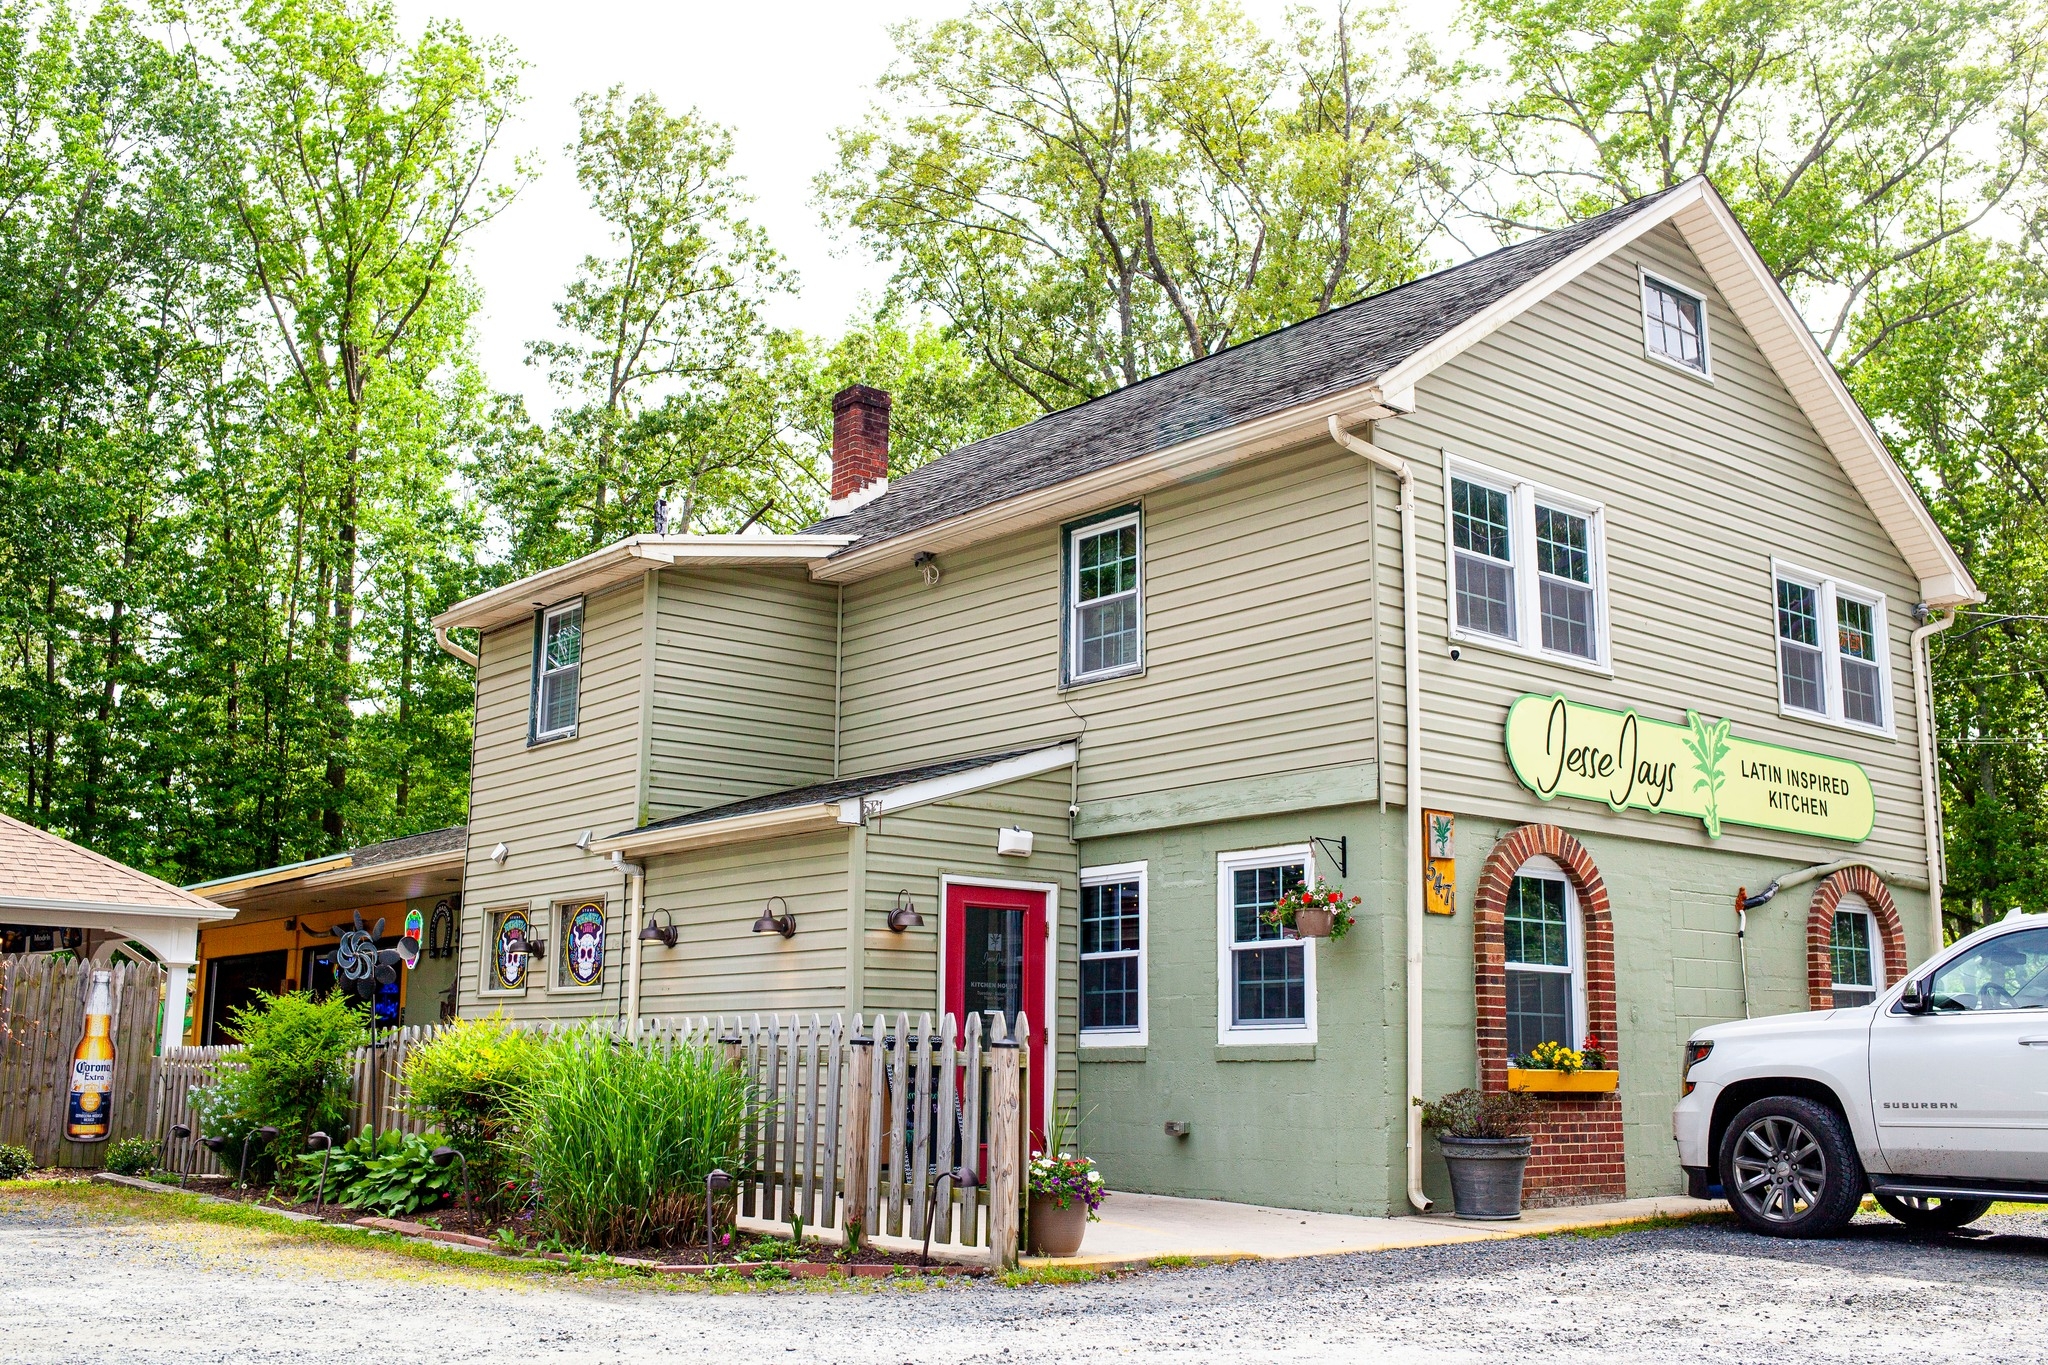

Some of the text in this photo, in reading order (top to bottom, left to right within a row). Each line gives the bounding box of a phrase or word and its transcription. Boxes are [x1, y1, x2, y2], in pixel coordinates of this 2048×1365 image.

[1537, 699, 1677, 807] Jesse Jays
[1741, 759, 1850, 796] LATIN INSPIRED
[1769, 790, 1829, 817] KITCHEN
[76, 1061, 112, 1075] Corona
[84, 1072, 105, 1081] Extra
